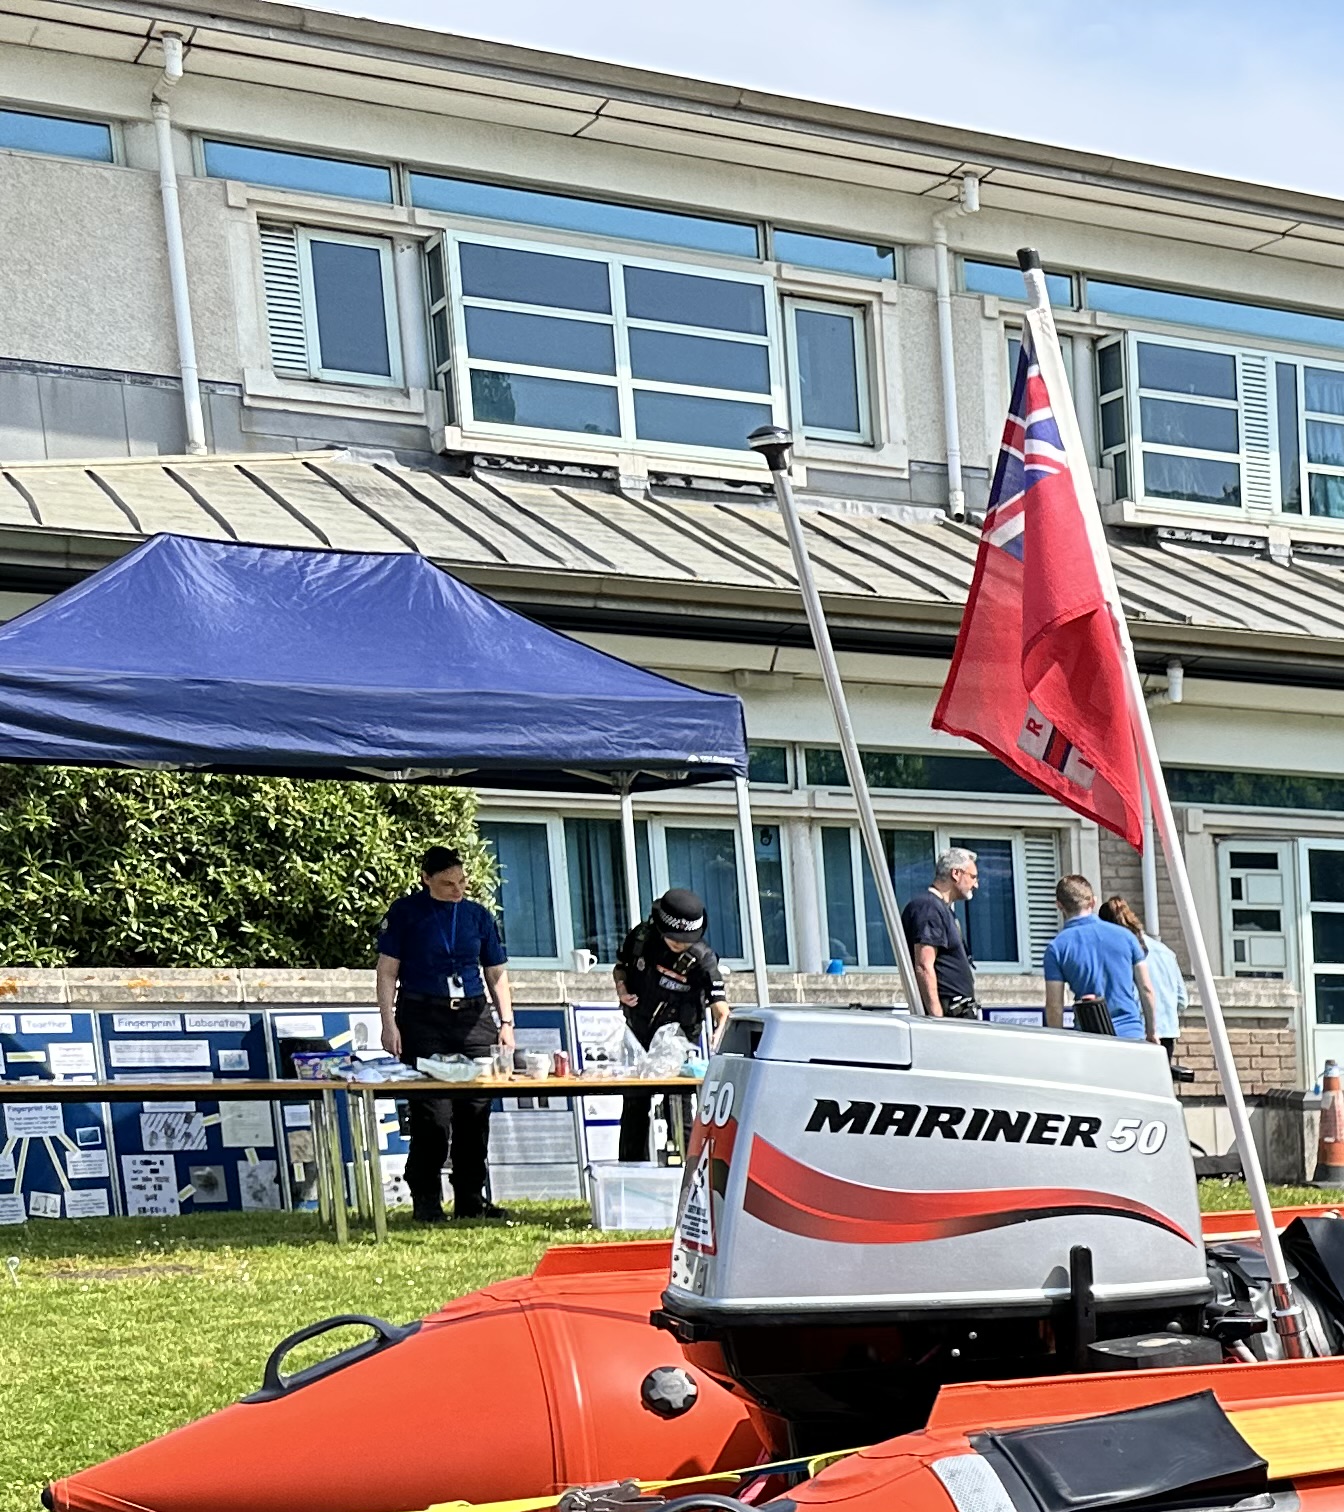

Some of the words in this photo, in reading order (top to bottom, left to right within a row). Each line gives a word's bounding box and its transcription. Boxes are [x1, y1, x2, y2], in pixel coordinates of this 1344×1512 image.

[117, 1018, 176, 1029] Fingerprint
[188, 1018, 247, 1029] Laboratory
[700, 1080, 735, 1128] 50
[804, 1098, 1103, 1148] MARINER
[1106, 1118, 1168, 1155] 50
